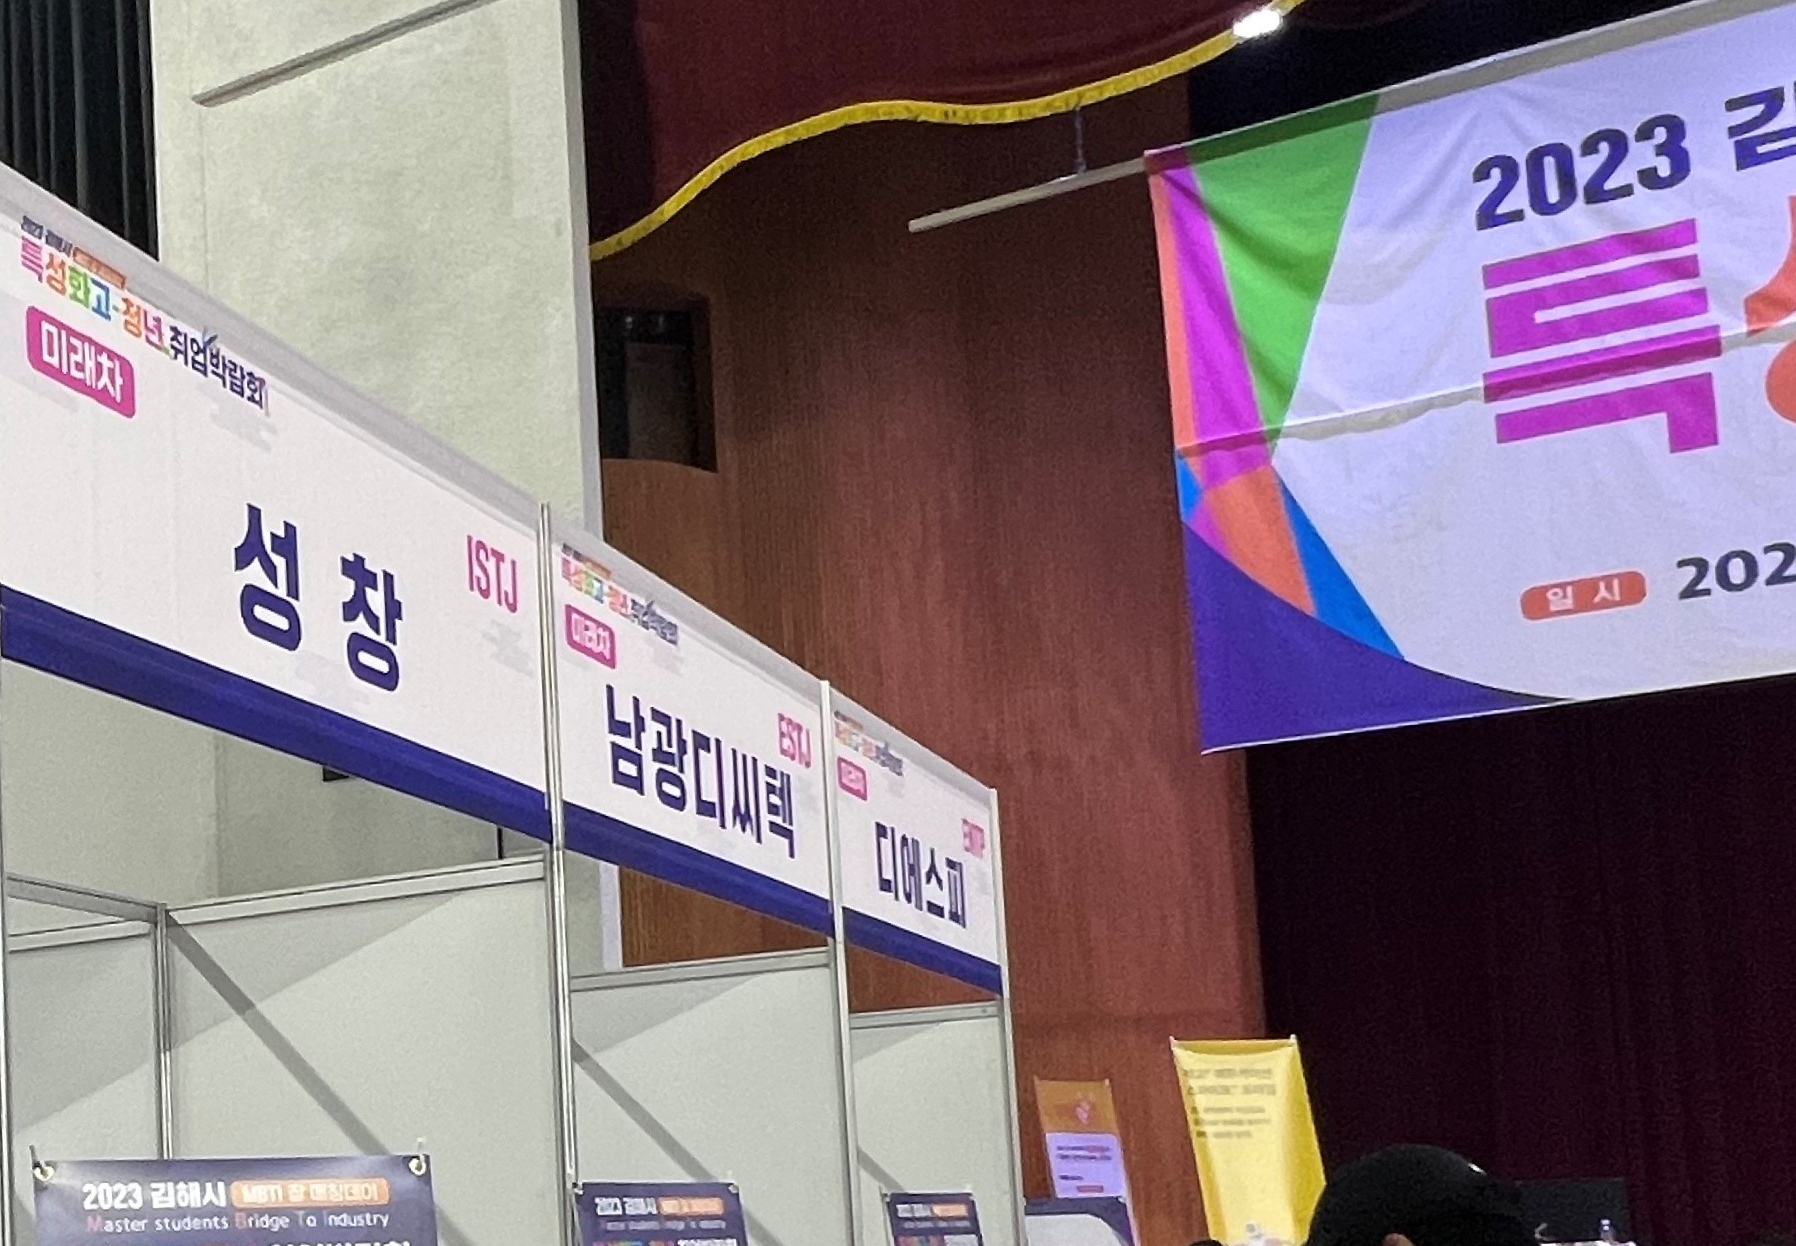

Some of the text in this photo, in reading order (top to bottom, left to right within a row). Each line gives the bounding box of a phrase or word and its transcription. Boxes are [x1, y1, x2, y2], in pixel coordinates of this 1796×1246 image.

[1472, 113, 1691, 230] 2023
[41, 320, 124, 403] 미래차
[466, 535, 518, 612] ISTJ
[605, 684, 796, 858] 남광디씨텍
[778, 712, 812, 768] ESTJ
[875, 821, 967, 928] 디에스피
[82, 1182, 143, 1211] 2023
[150, 1180, 227, 1210] 김해시
[87, 1215, 148, 1233] Master
[155, 1213, 229, 1231] students
[235, 1210, 290, 1232] Bridge
[323, 1210, 390, 1230] Industry
